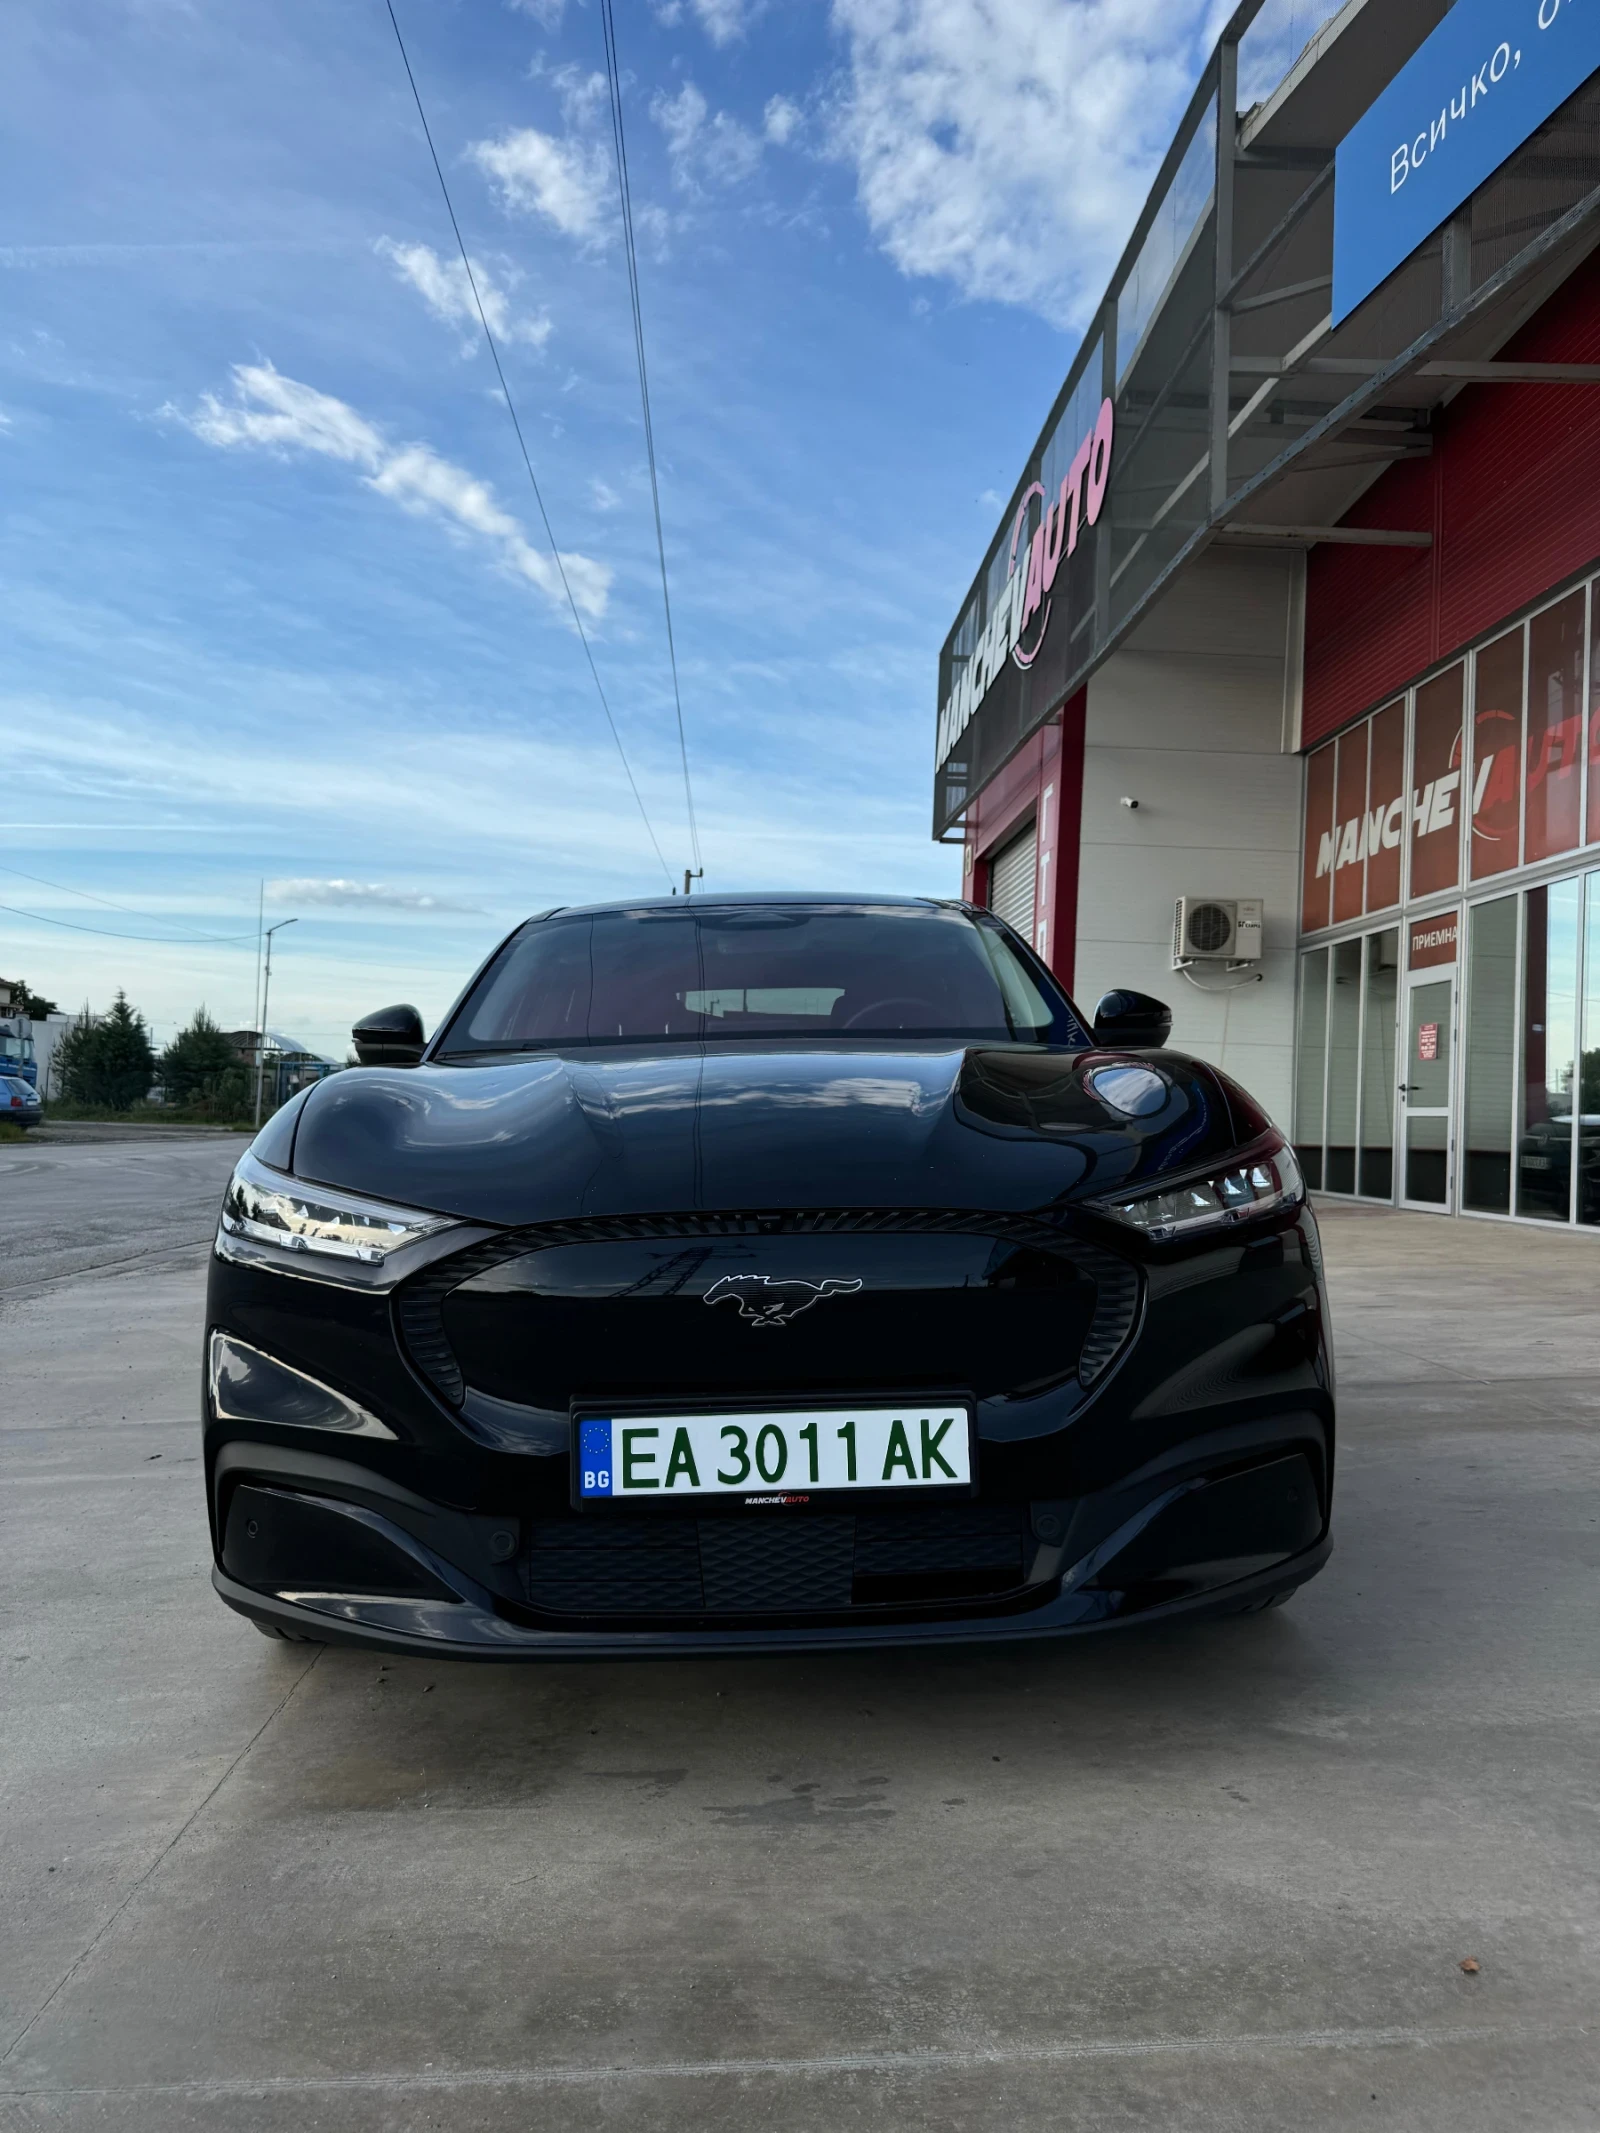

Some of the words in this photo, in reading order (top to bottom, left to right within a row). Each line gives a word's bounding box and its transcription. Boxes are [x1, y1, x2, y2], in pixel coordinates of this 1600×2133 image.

[1390, 42, 1521, 195] Всичко,
[584, 1470, 610, 1489] BG
[621, 1426, 701, 1489] EA
[717, 1421, 857, 1485] 3011
[881, 1418, 958, 1481] AK
